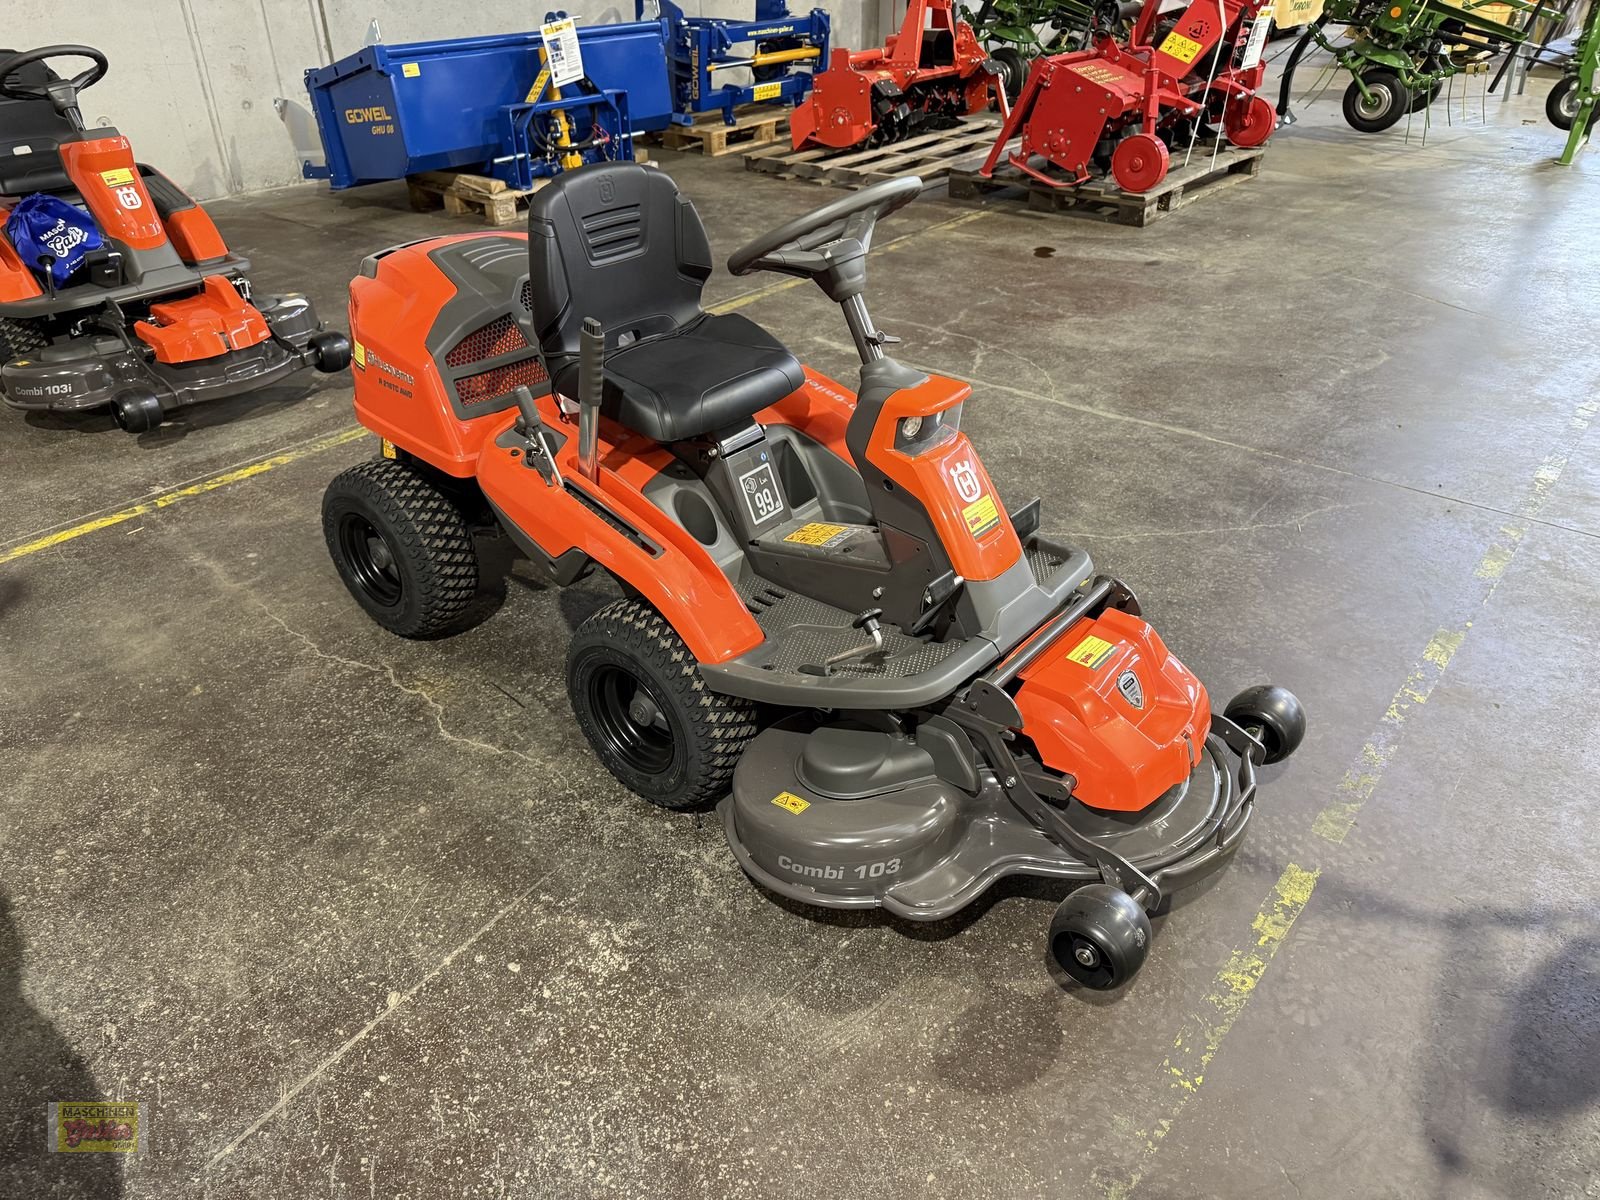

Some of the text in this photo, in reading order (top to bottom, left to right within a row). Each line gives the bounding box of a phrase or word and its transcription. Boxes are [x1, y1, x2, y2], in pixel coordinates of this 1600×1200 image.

[371, 125, 386, 135] GHU
[15, 384, 72, 396] Combi 103i
[754, 488, 775, 516] 99
[778, 855, 901, 880] Combi 103
